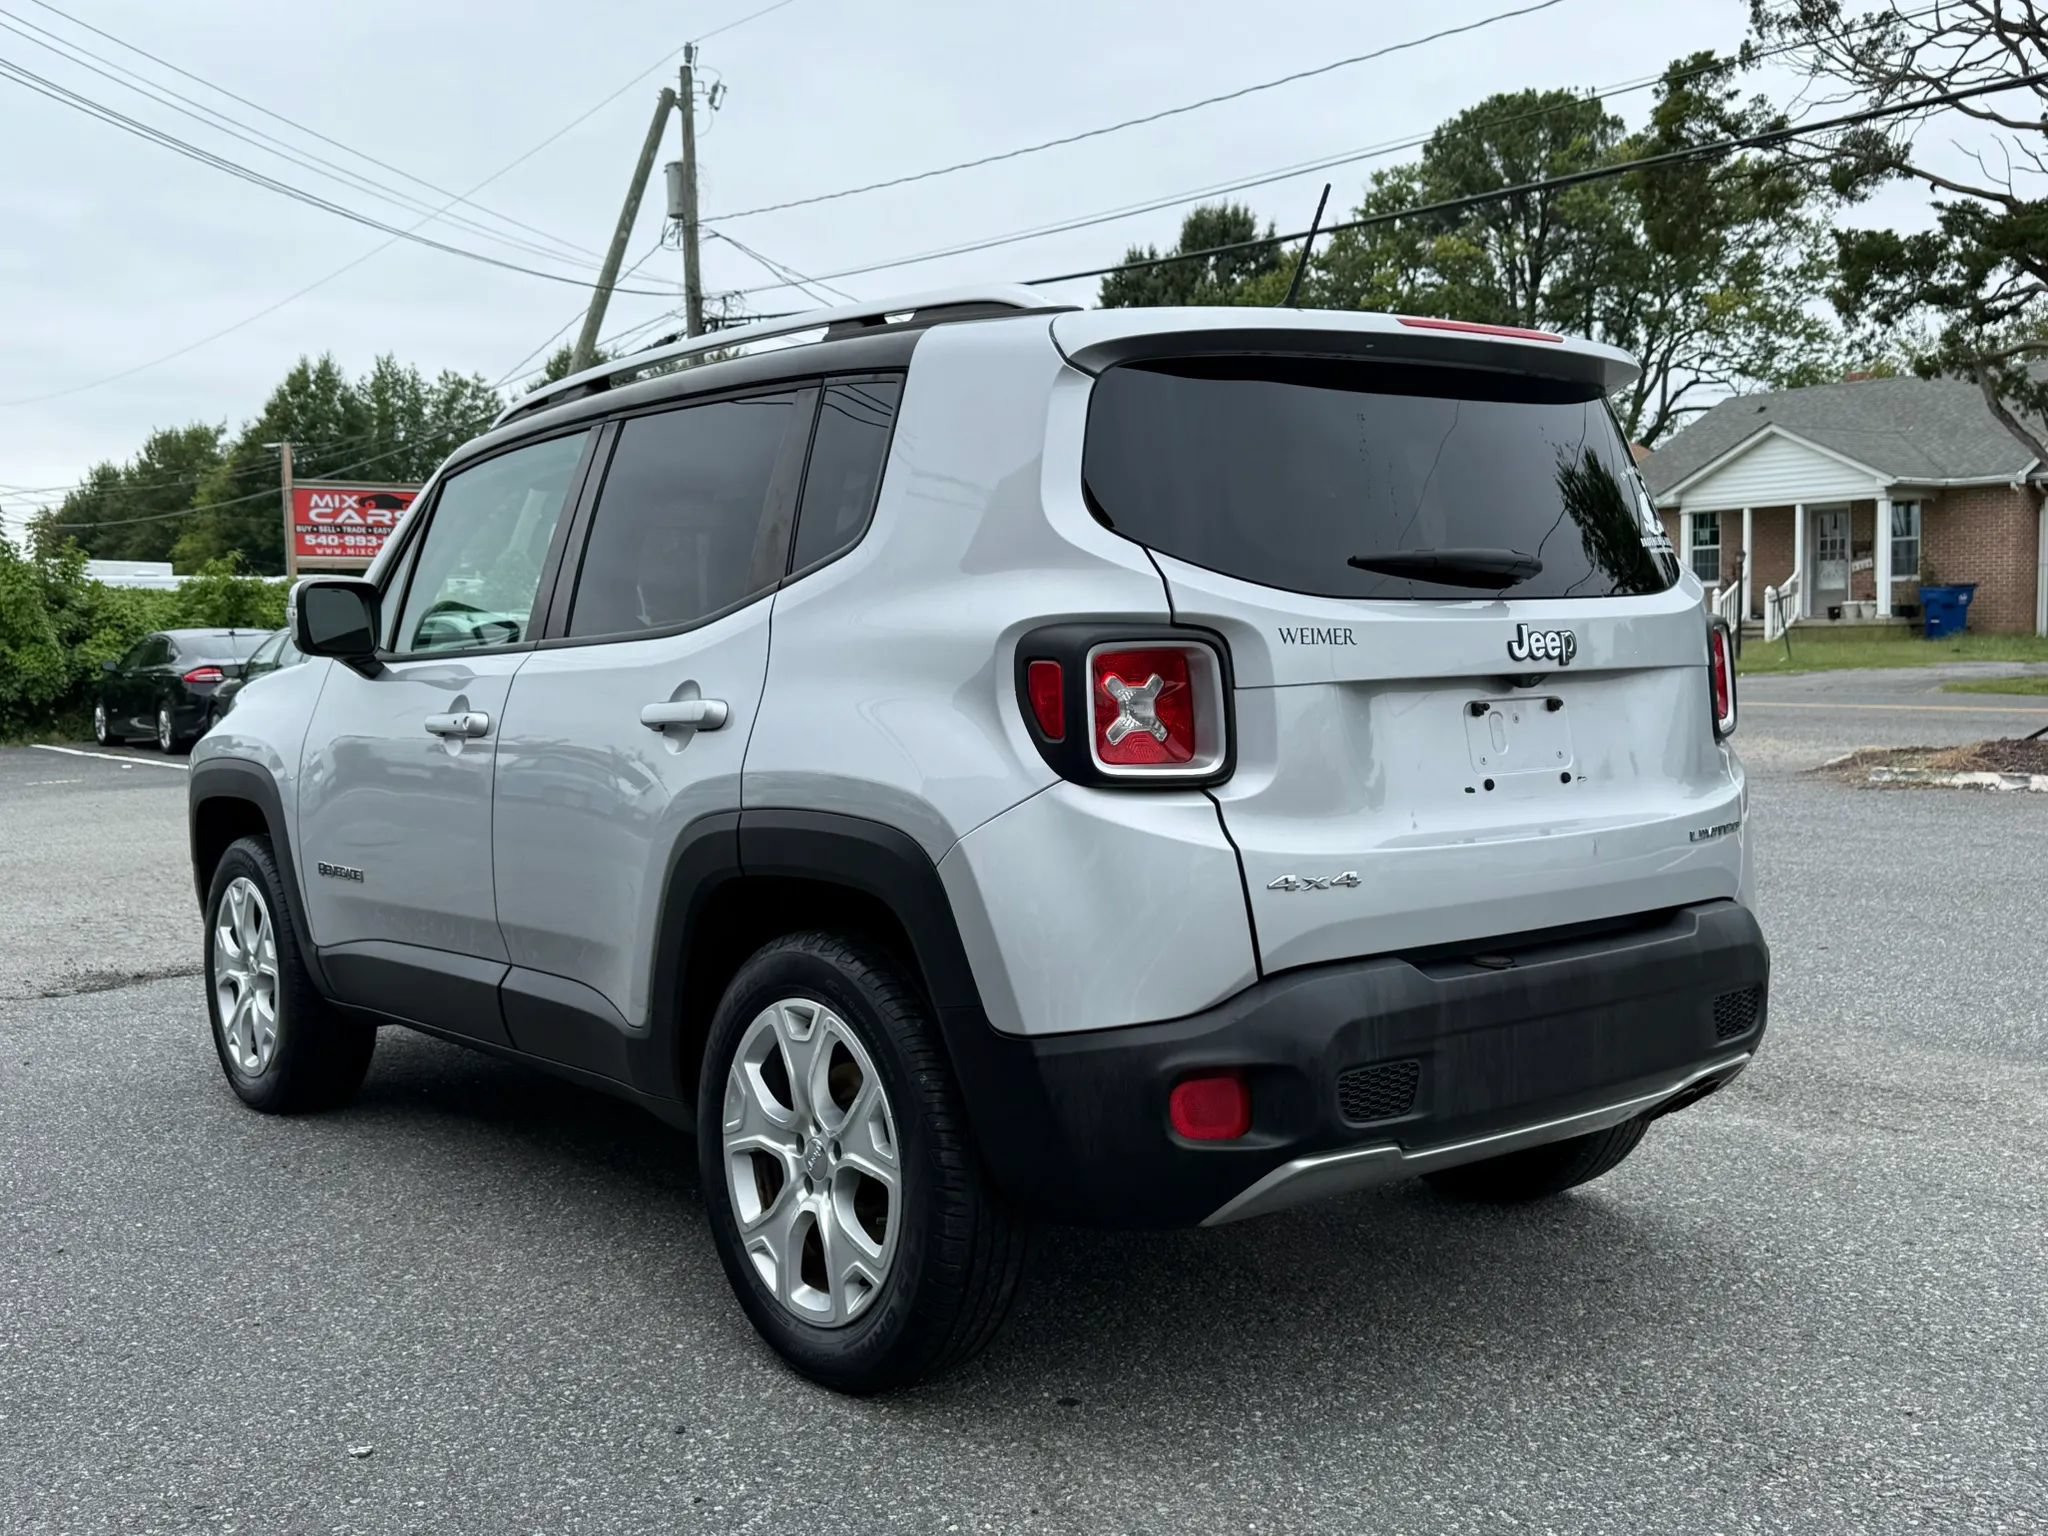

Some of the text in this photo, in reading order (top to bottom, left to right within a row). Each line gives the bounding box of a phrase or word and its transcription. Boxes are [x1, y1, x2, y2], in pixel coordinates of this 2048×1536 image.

[310, 494, 360, 508] MIX
[296, 525, 312, 533] BUY
[318, 525, 336, 533] SELL
[342, 526, 366, 534] TRADE
[304, 535, 389, 546] 540-993-
[1278, 627, 1357, 647] WEIMER
[1508, 623, 1577, 666] Jeep
[318, 860, 364, 883] RENEGADE
